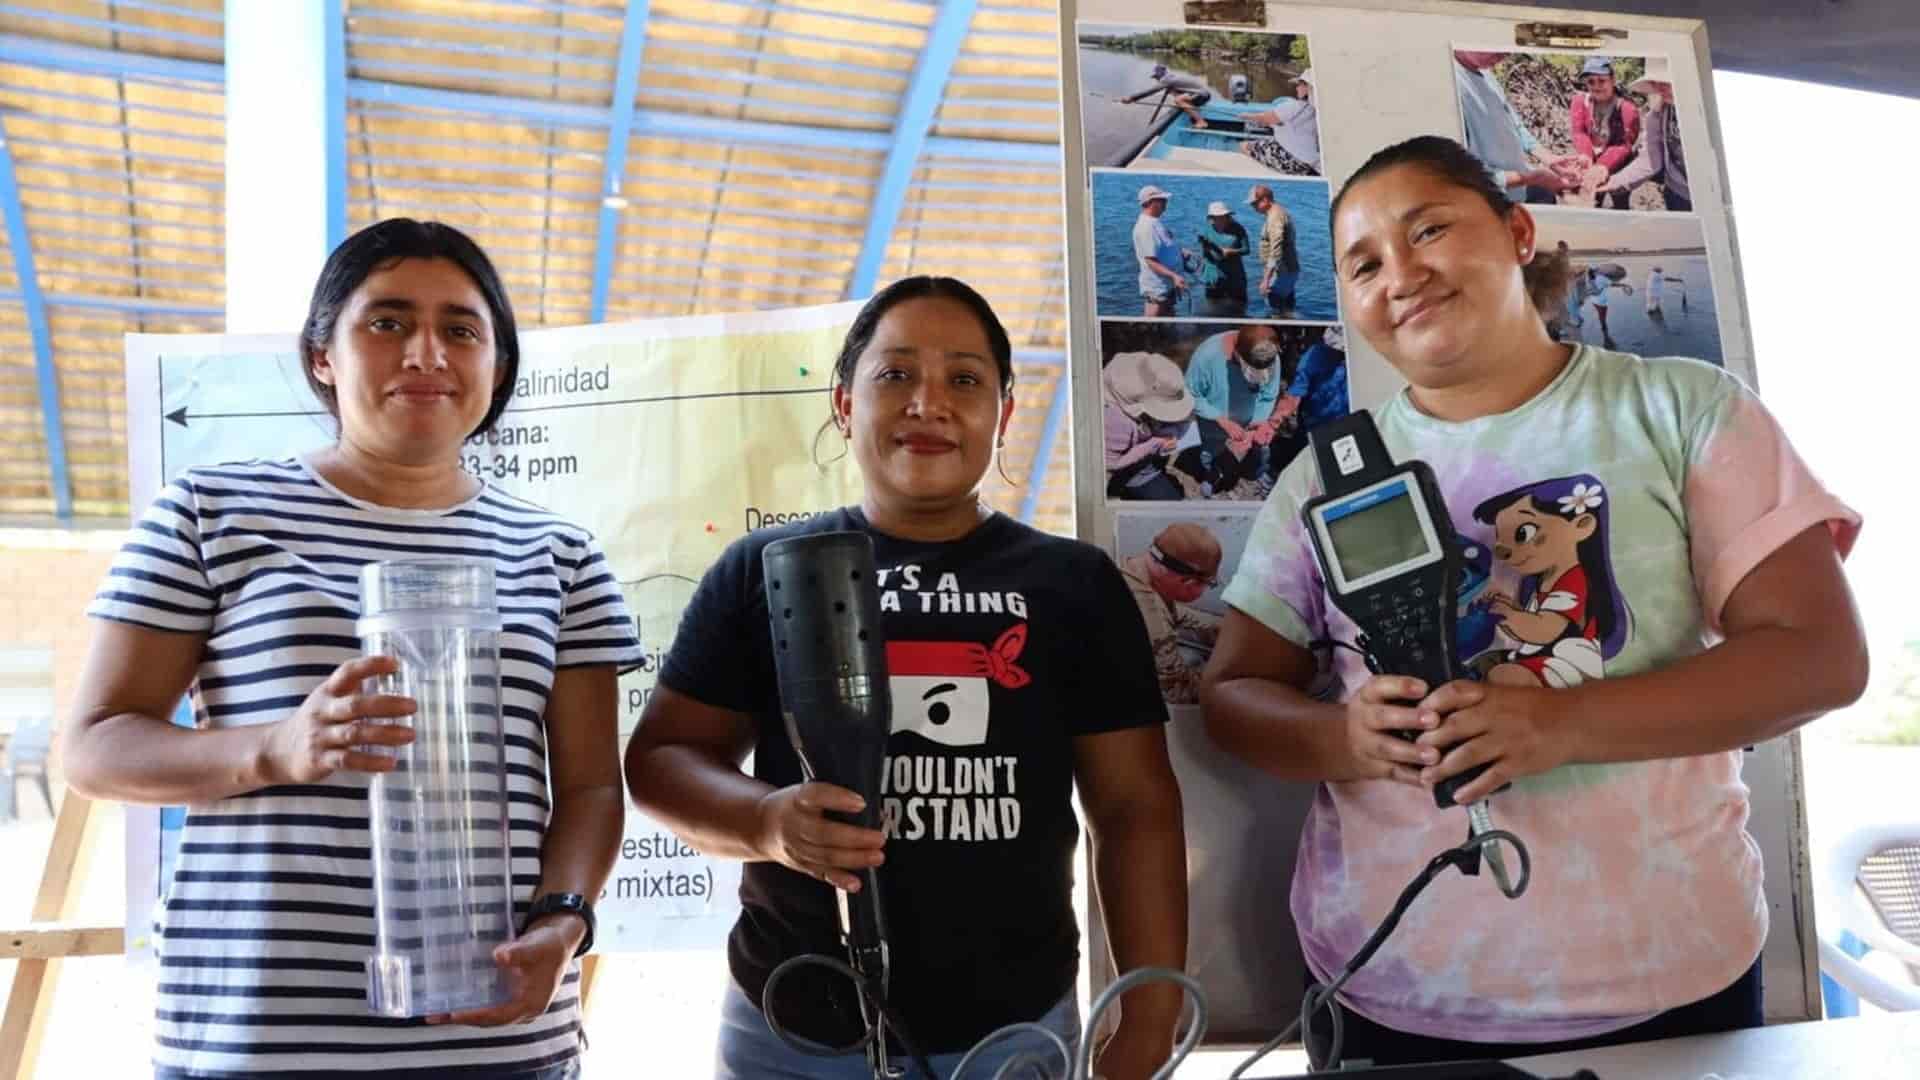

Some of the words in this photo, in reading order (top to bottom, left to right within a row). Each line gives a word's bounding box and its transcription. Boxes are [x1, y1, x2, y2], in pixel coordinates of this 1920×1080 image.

[516, 363, 609, 398] alinidad
[463, 425, 549, 446] ocana:
[528, 455, 578, 482] ppm
[876, 564, 922, 591] T'S
[936, 571, 960, 593] A
[917, 591, 1028, 620] THING
[880, 755, 1018, 795] OULDN'T
[880, 797, 1021, 841] RSTAND
[622, 832, 701, 860] estua
[617, 865, 714, 904] mixtas)
